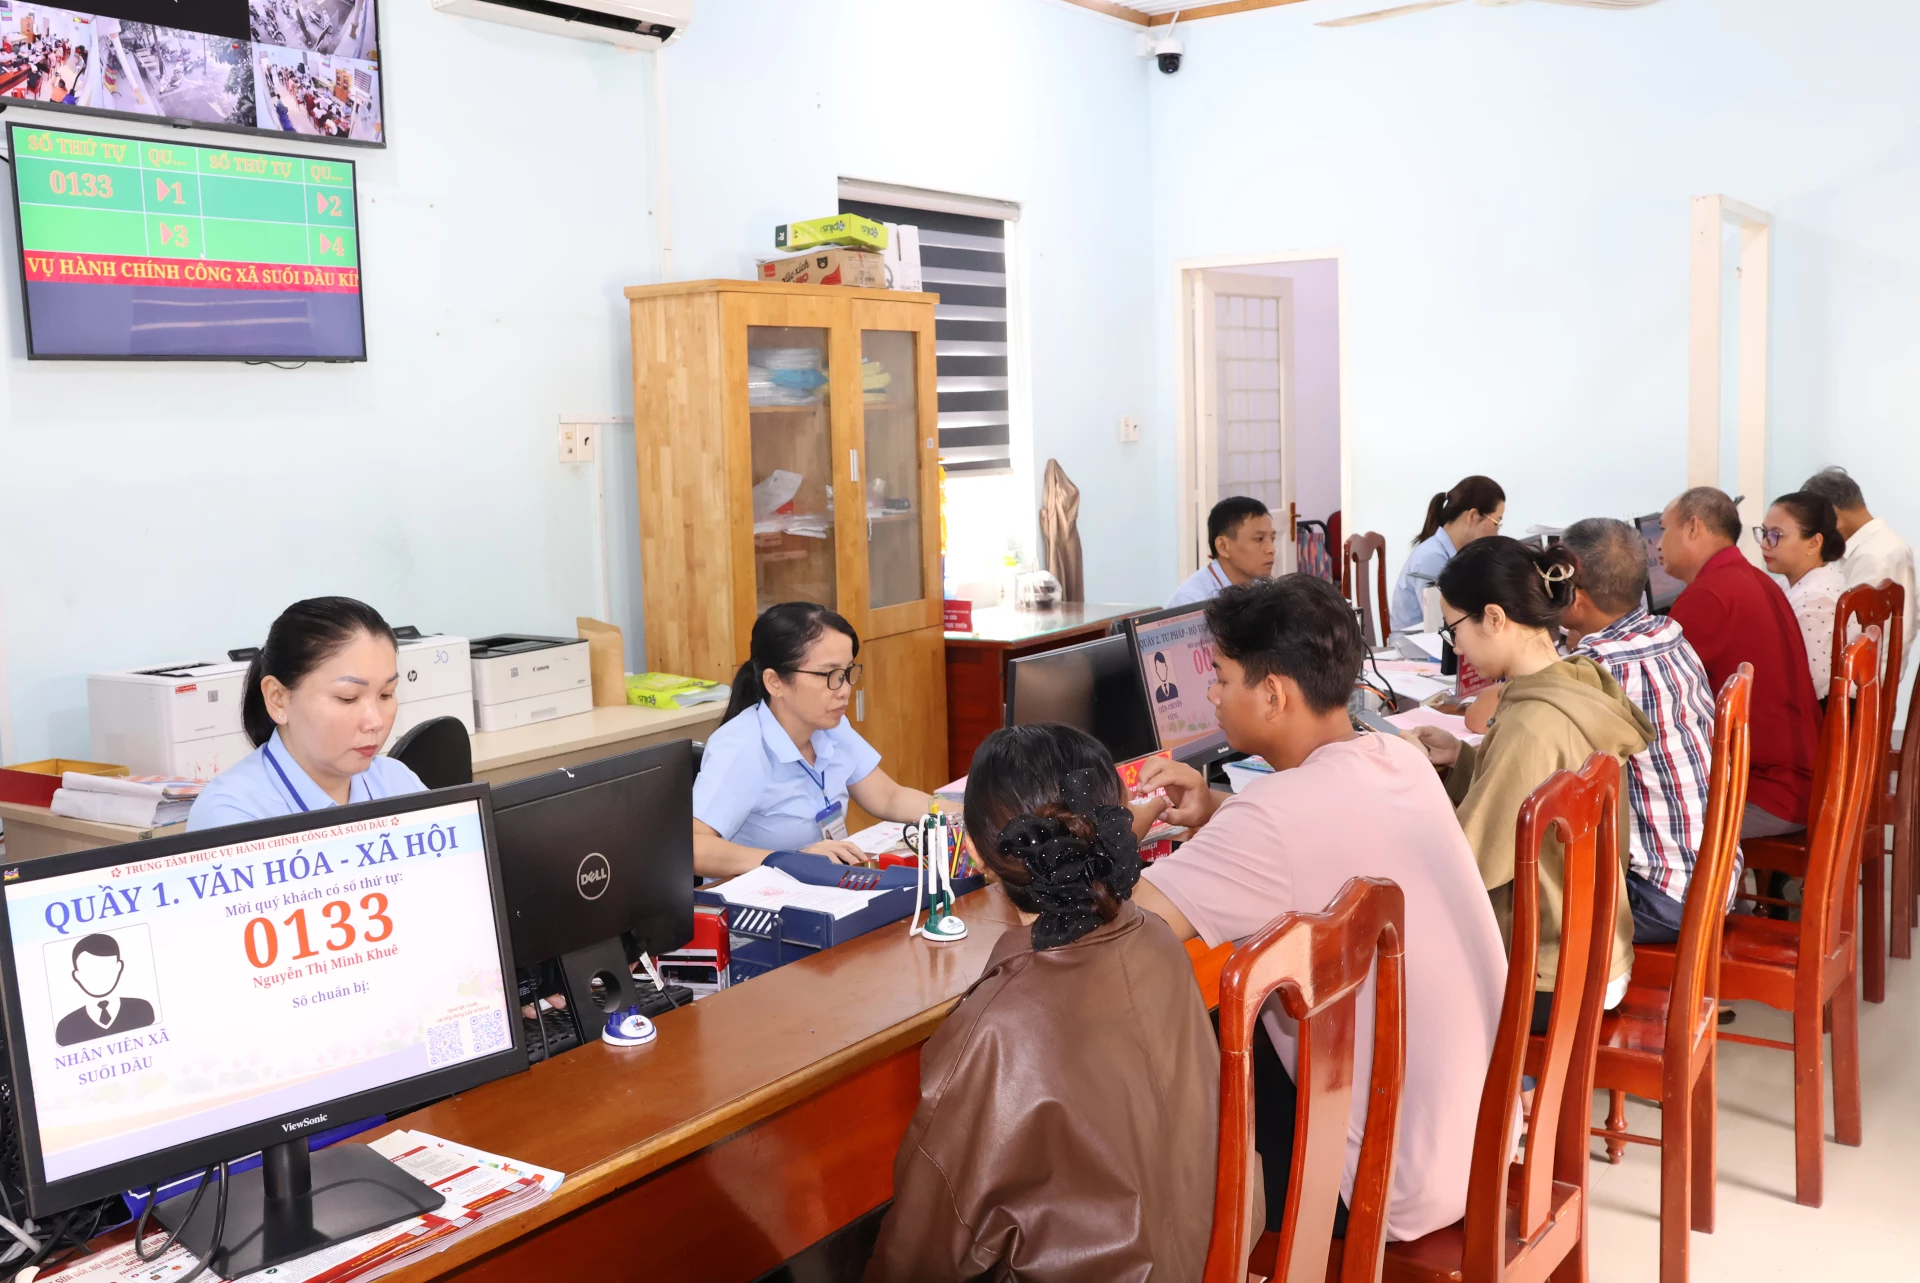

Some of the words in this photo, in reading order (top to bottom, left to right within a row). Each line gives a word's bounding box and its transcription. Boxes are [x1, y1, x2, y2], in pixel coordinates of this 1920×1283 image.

[28, 133, 53, 152] SỐ
[56, 137, 98, 157] THỨ
[100, 142, 127, 163] TỰ
[209, 152, 231, 170] SỐ
[233, 156, 268, 174] THỨ
[270, 161, 292, 179] TỰ
[50, 170, 113, 199] 0133
[171, 181, 186, 205] 1
[329, 195, 343, 216] 2
[174, 224, 189, 248] 3
[331, 236, 345, 257] 4
[27, 257, 54, 278] VỤ
[59, 256, 117, 277] HÀNH
[120, 260, 181, 280] CHÍNH
[184, 262, 232, 281] CÔNG
[236, 265, 259, 283] XÃ
[262, 266, 300, 285] SUỐI
[303, 268, 335, 287] DẦU
[434, 650, 449, 664] 30
[532, 664, 550, 672] Canon
[125, 861, 162, 875] TRUNG
[163, 856, 187, 868] TÂM
[189, 851, 218, 863] PHỤC
[220, 847, 233, 858] VỤ
[236, 842, 266, 854] HÀNH
[268, 835, 299, 849] CHÍNH
[302, 831, 328, 842] CÔNG
[331, 826, 344, 837] XÃ
[44, 885, 142, 934] QUẦY
[152, 882, 180, 908] 1.
[186, 863, 254, 900] VĂN
[263, 848, 334, 886] HÓA
[356, 832, 399, 867] XÃ
[404, 824, 459, 863] HỘI
[581, 868, 607, 885] DELL
[225, 902, 251, 917] Mời
[255, 896, 280, 914] quý
[283, 887, 322, 905] khách
[326, 884, 340, 896] có
[343, 880, 357, 892] số
[360, 876, 382, 889] thứ
[386, 873, 403, 885] tự:
[244, 892, 393, 969] 0133
[252, 966, 303, 989] Nguyễn
[306, 960, 328, 975] Thị
[330, 952, 364, 970] Minh
[366, 944, 398, 961] Khuê
[292, 994, 308, 1009] Số
[311, 986, 350, 1005] chuẩn
[353, 980, 370, 995] bị:
[54, 1046, 102, 1070] NHÂN
[107, 1036, 144, 1056] VIÊN
[148, 1028, 170, 1046] XÃ
[78, 1063, 116, 1086] SUỐI
[281, 1113, 328, 1133] ViewSonic
